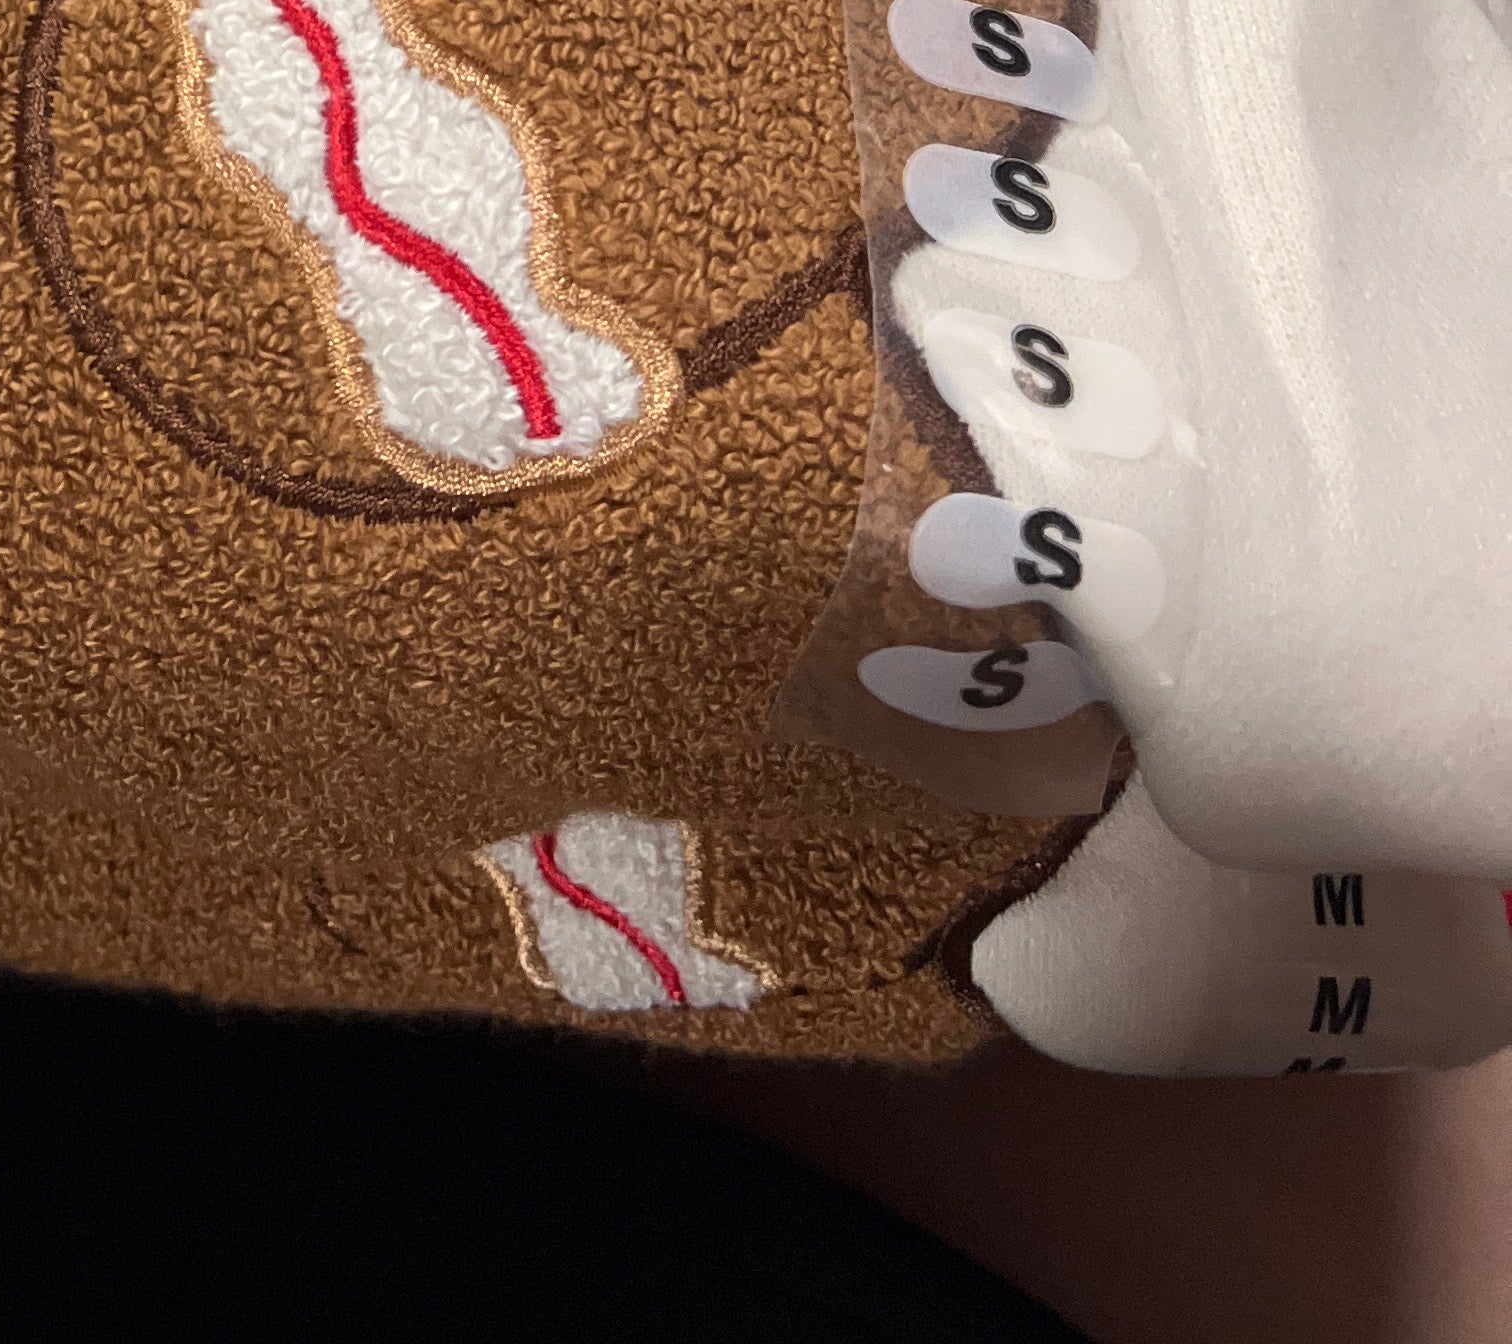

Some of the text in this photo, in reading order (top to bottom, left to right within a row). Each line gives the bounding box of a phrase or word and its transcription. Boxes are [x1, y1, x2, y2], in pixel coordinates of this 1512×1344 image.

[969, 5, 1032, 78] S
[990, 156, 1057, 234] S
[1011, 324, 1074, 408] S
[1014, 507, 1083, 591] S
[960, 644, 1029, 709] S
[1312, 873, 1365, 927] M
[1308, 976, 1372, 1036] M
